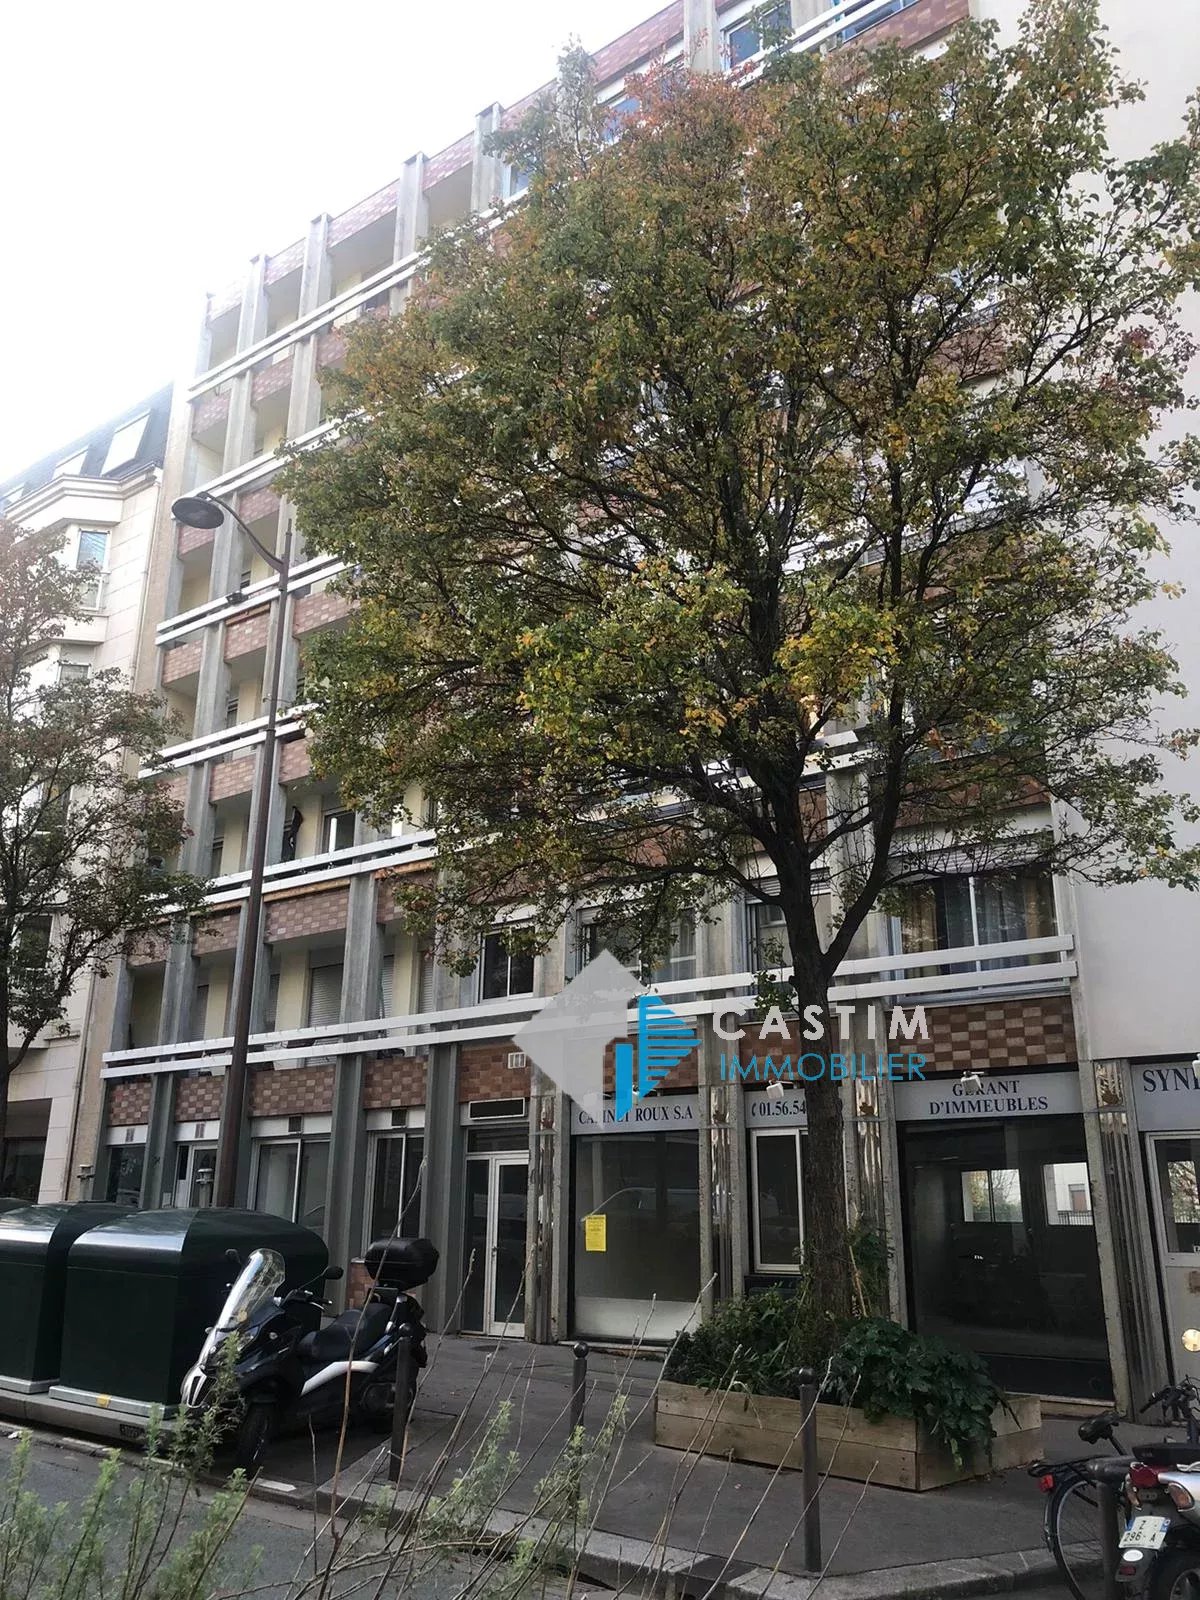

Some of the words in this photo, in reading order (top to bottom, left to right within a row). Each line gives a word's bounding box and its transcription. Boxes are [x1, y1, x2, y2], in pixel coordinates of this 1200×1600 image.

[952, 1080, 1020, 1097] GRANT
[635, 1106, 670, 1121] ROUX
[674, 1104, 693, 1119] S.A
[929, 1096, 1049, 1115] D'IMMEUBLES
